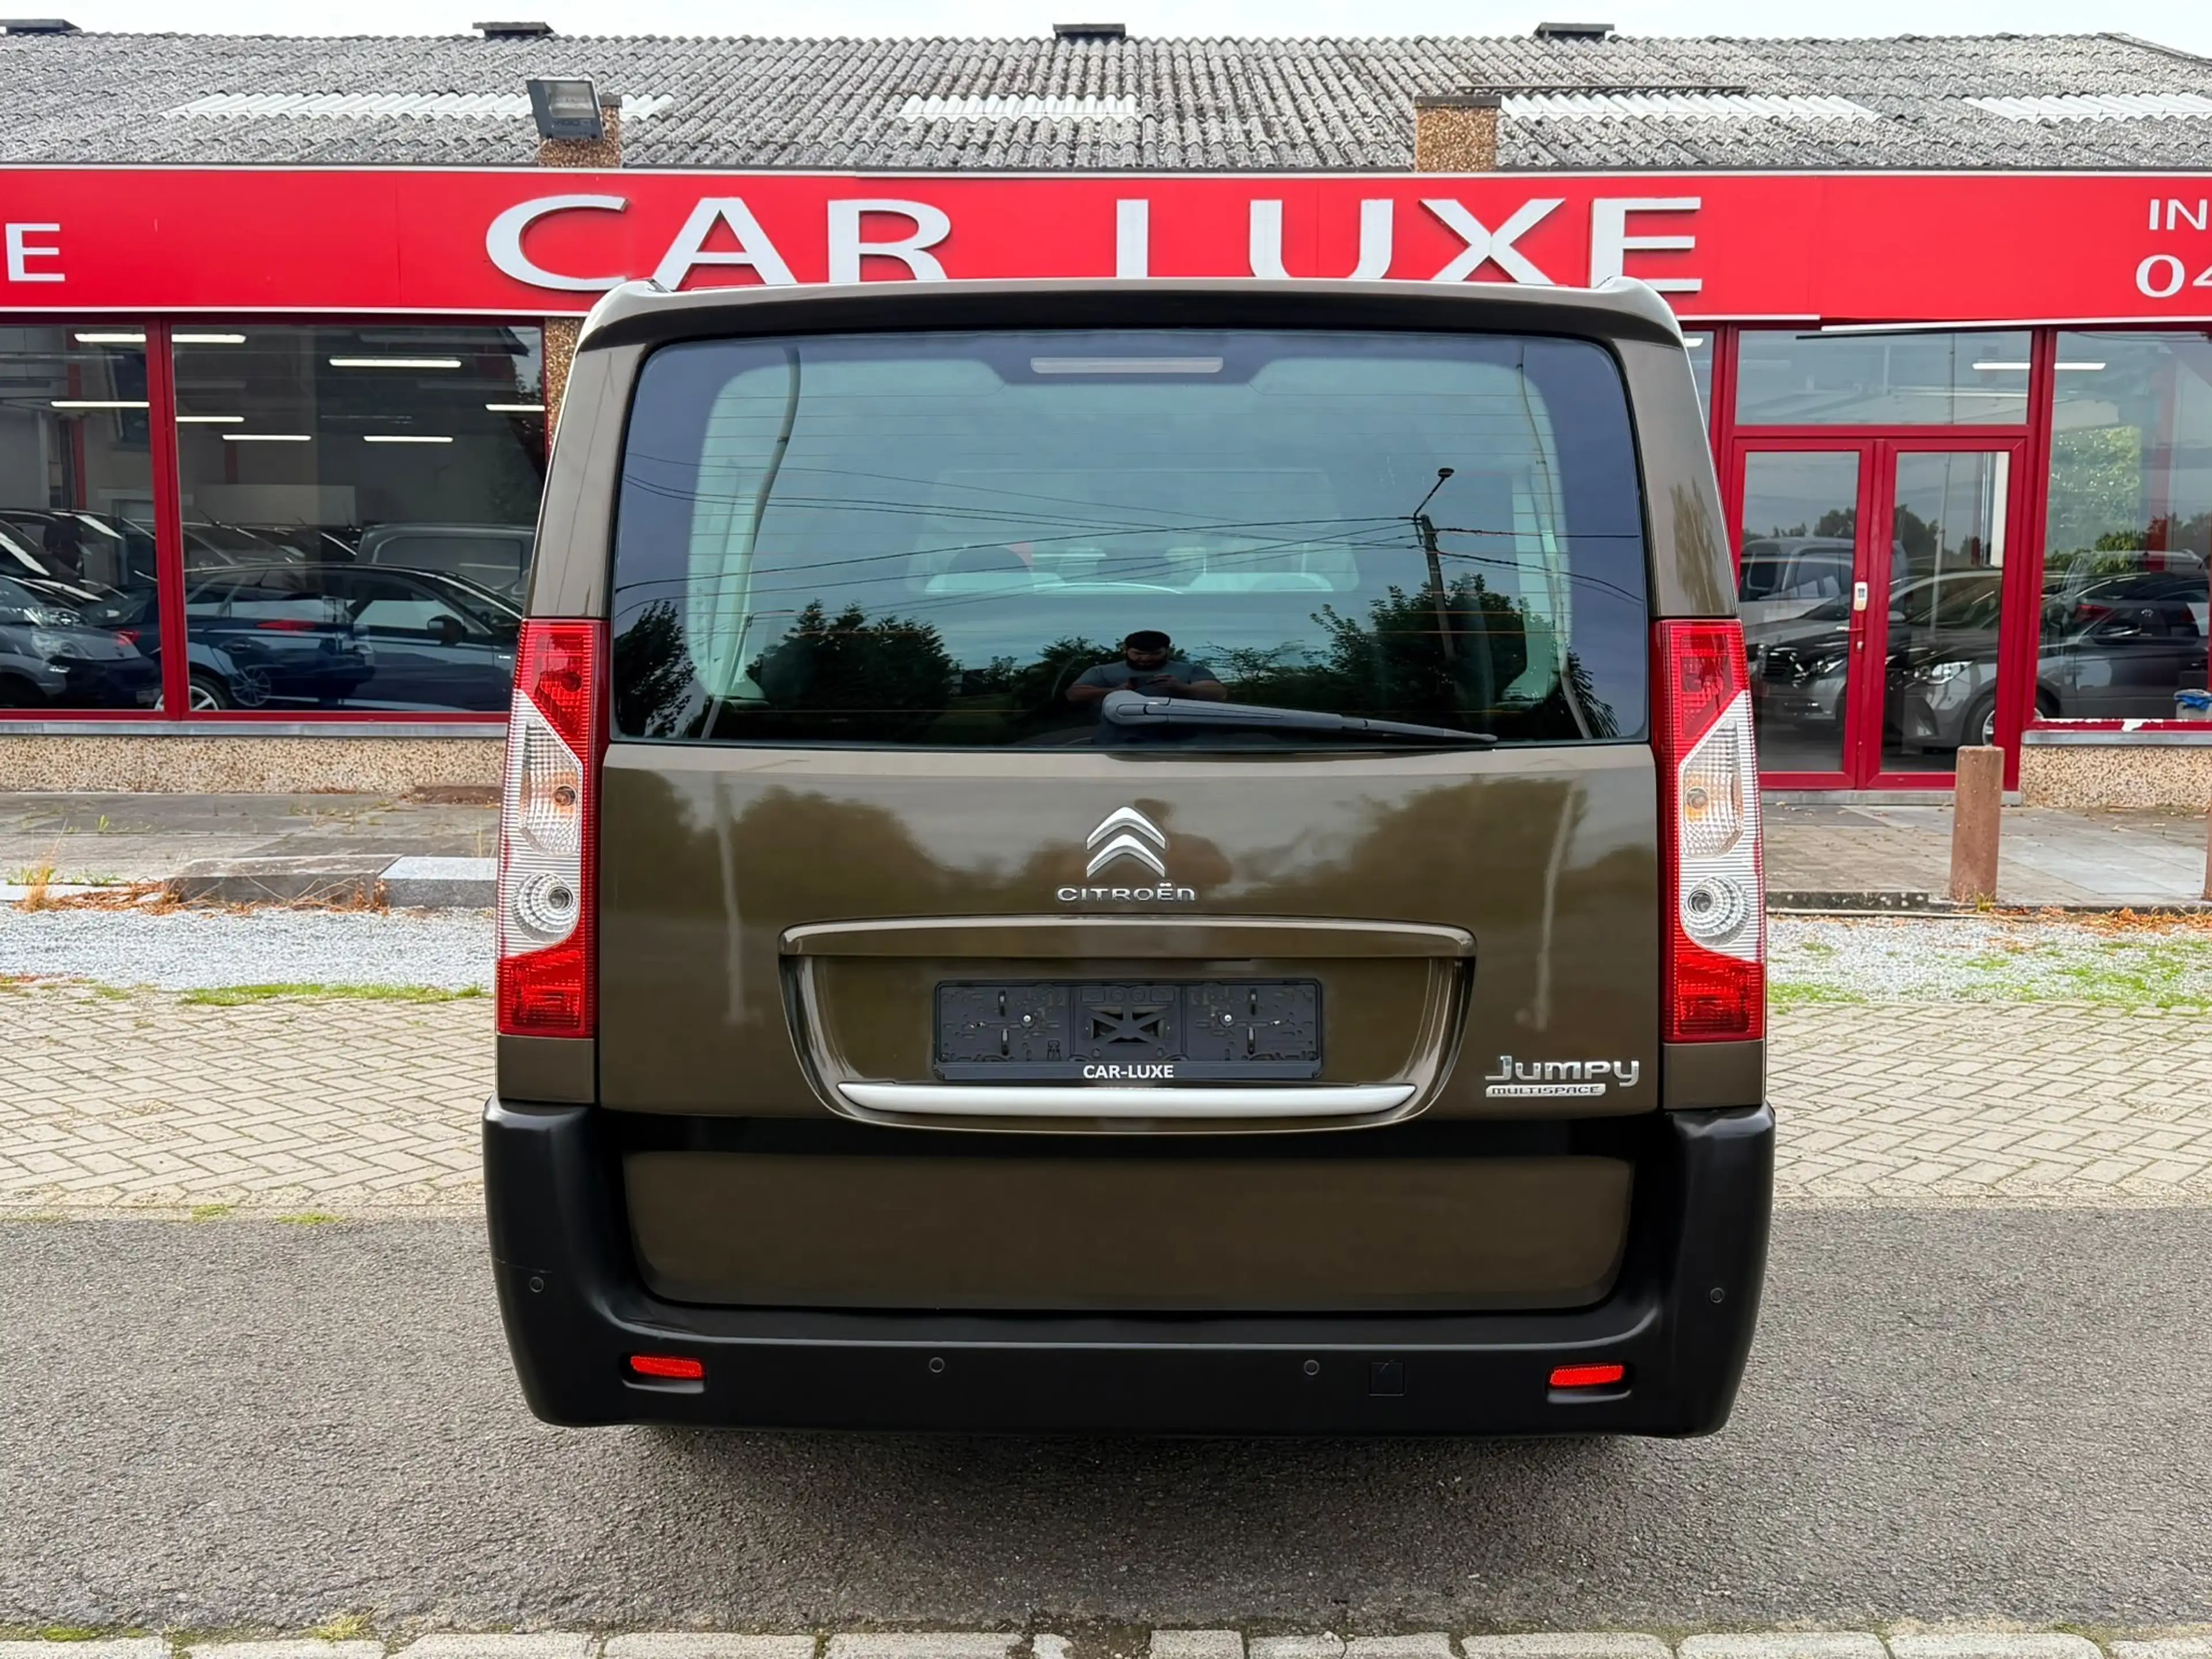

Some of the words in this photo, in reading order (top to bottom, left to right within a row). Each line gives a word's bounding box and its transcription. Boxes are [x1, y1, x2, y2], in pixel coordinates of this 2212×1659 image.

[5, 223, 65, 281] E
[486, 194, 952, 291] CAR
[1056, 882, 1196, 901] CITROËN
[1083, 1065, 1174, 1079] CAR-LUXE
[1484, 1055, 1639, 1087] Jumpy
[1491, 1085, 1601, 1094] MULTISPACE
